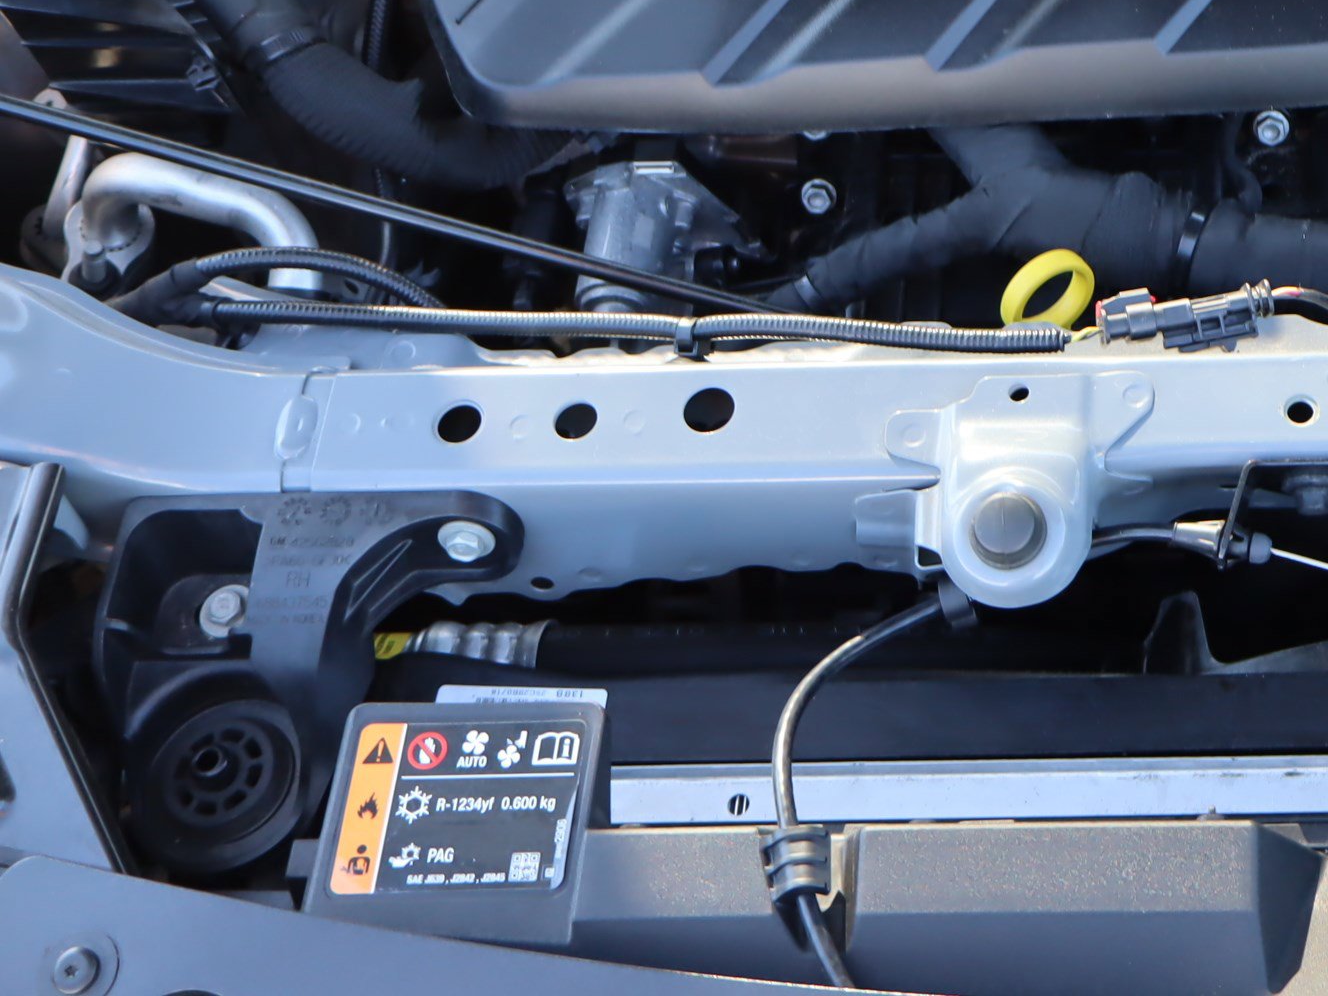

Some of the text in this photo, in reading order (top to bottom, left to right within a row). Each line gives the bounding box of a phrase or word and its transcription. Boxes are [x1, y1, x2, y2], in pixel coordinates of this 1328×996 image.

[456, 756, 488, 768] AUTO
[435, 796, 556, 814] R-1234yf 0.600 kg
[427, 848, 455, 863] PAG
